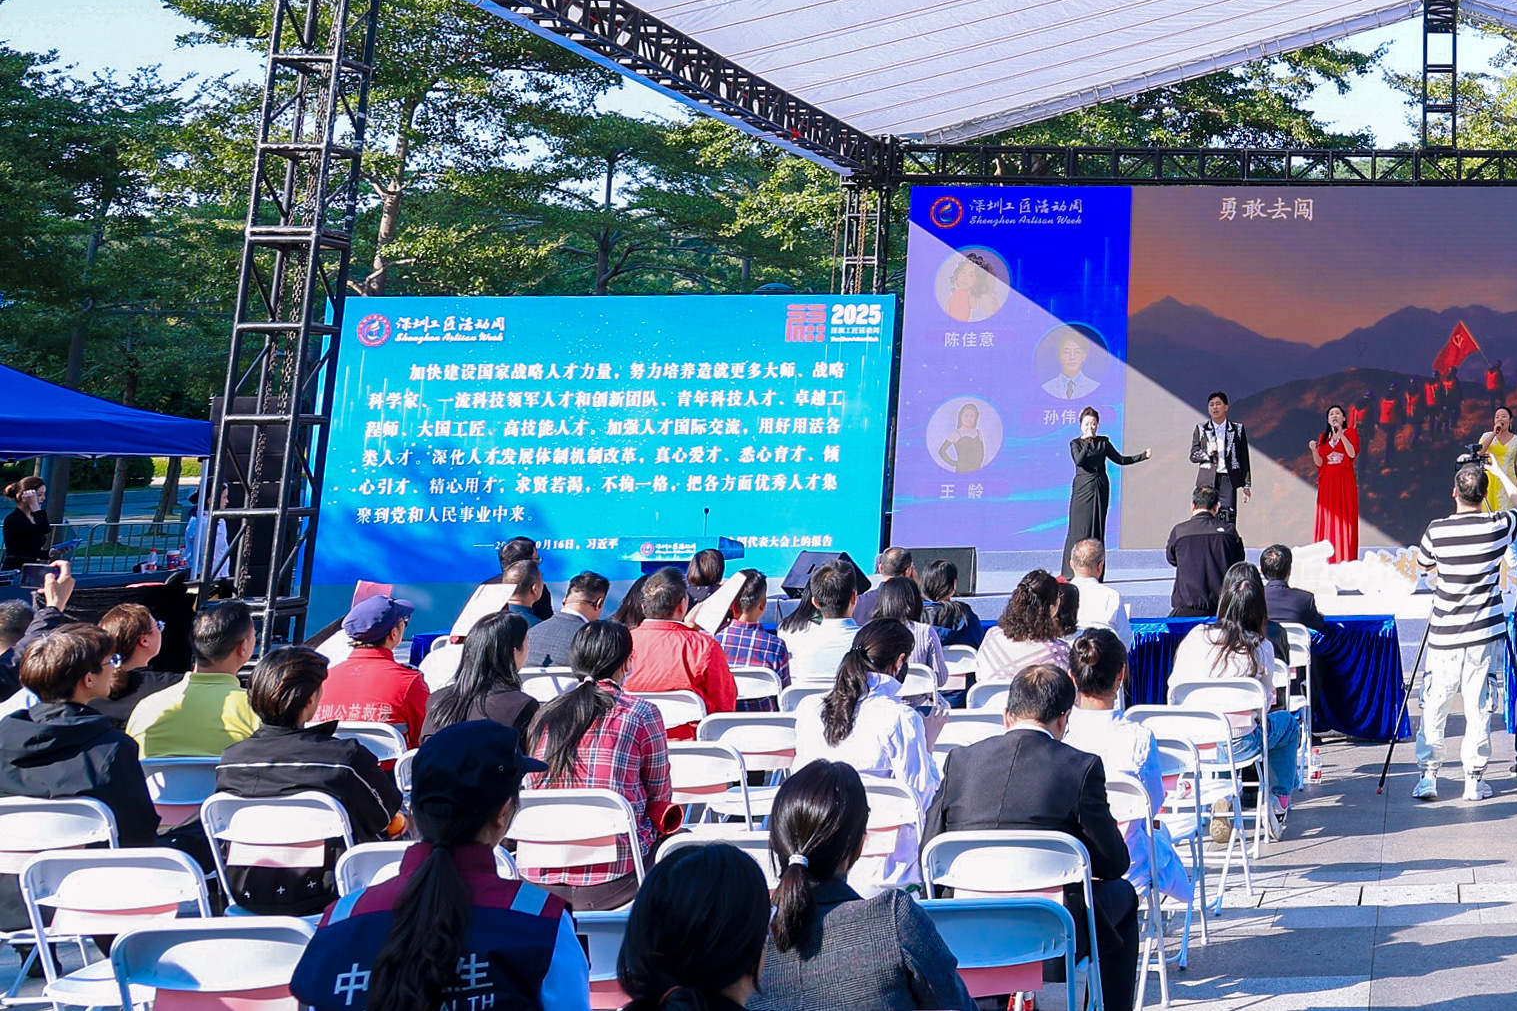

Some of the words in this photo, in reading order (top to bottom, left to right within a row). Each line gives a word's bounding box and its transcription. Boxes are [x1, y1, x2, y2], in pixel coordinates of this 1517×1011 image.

[969, 197, 1083, 214] 深圳工匠活动周
[1219, 197, 1315, 222] 勇敢去闯
[969, 215, 1016, 227] Shenzhen
[1018, 215, 1054, 224] Artisan
[1056, 215, 1082, 224] Week
[831, 304, 881, 325] 2025
[395, 316, 506, 332] 深圳工匠活动周
[943, 331, 996, 348] 陈佳意
[1044, 409, 1083, 425] 孙伟
[356, 505, 534, 524] 聚到党和人民事业中来。
[334, 953, 494, 1006] 中生
